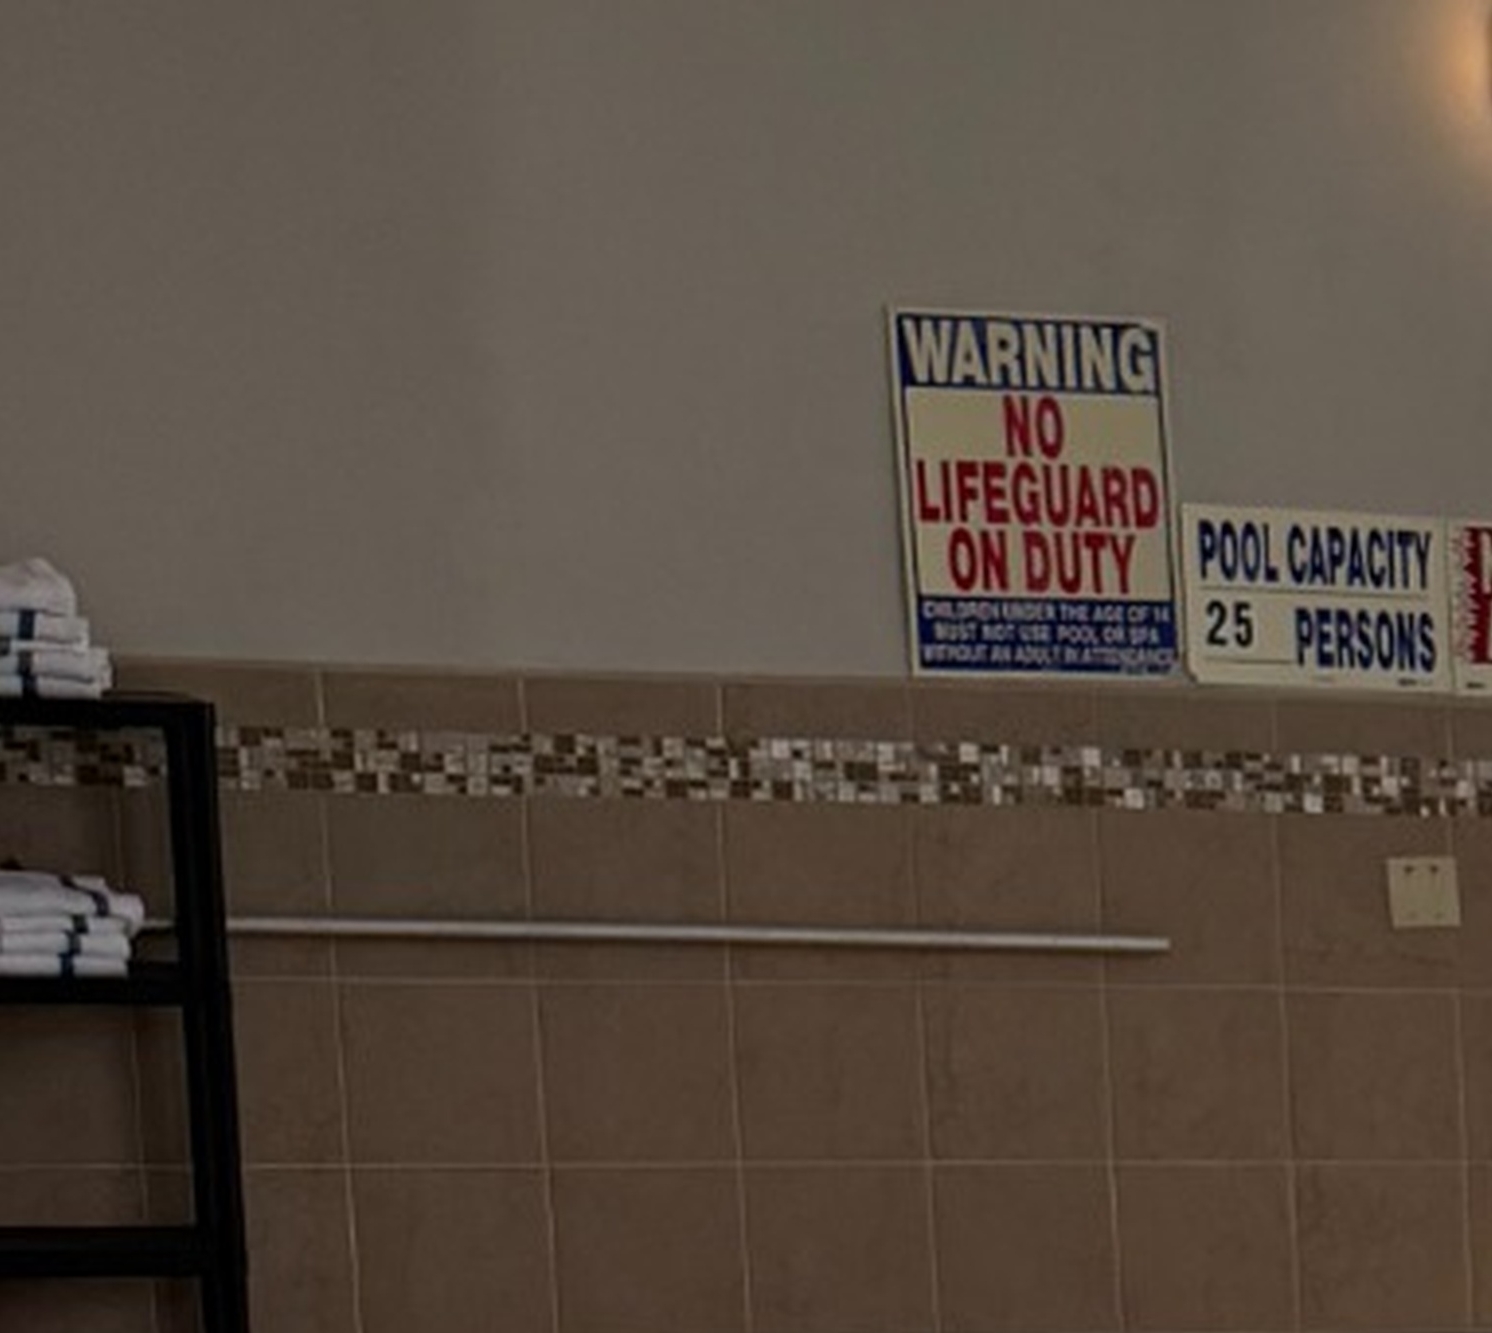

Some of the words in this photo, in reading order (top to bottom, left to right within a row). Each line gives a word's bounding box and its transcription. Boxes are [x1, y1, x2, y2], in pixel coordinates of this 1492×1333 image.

[901, 318, 1157, 392] WARNING
[1003, 395, 1064, 459] NO
[916, 460, 1159, 529] LIFEGUARD
[949, 527, 1009, 591] ON
[1023, 530, 1136, 594] DUTY
[1198, 519, 1279, 582] POOL
[1287, 525, 1431, 590] CAPACITY
[923, 602, 1000, 619] CHILDREN
[1002, 603, 1056, 620] UNDER
[1060, 604, 1090, 621] THE
[1093, 605, 1124, 622] AGE
[1127, 606, 1149, 622] OF
[934, 623, 978, 640] MUST
[982, 624, 1015, 641] NOT
[1019, 624, 1050, 641] USE
[1057, 625, 1099, 643] POOL
[1102, 626, 1125, 643] OR
[1130, 627, 1160, 644] SPA
[1206, 600, 1253, 647] 25
[1295, 607, 1436, 672] PERSONS
[923, 645, 987, 662] WITHOUT
[991, 646, 1011, 662] AN
[1015, 646, 1058, 664] ADULT
[1064, 647, 1082, 663] IN
